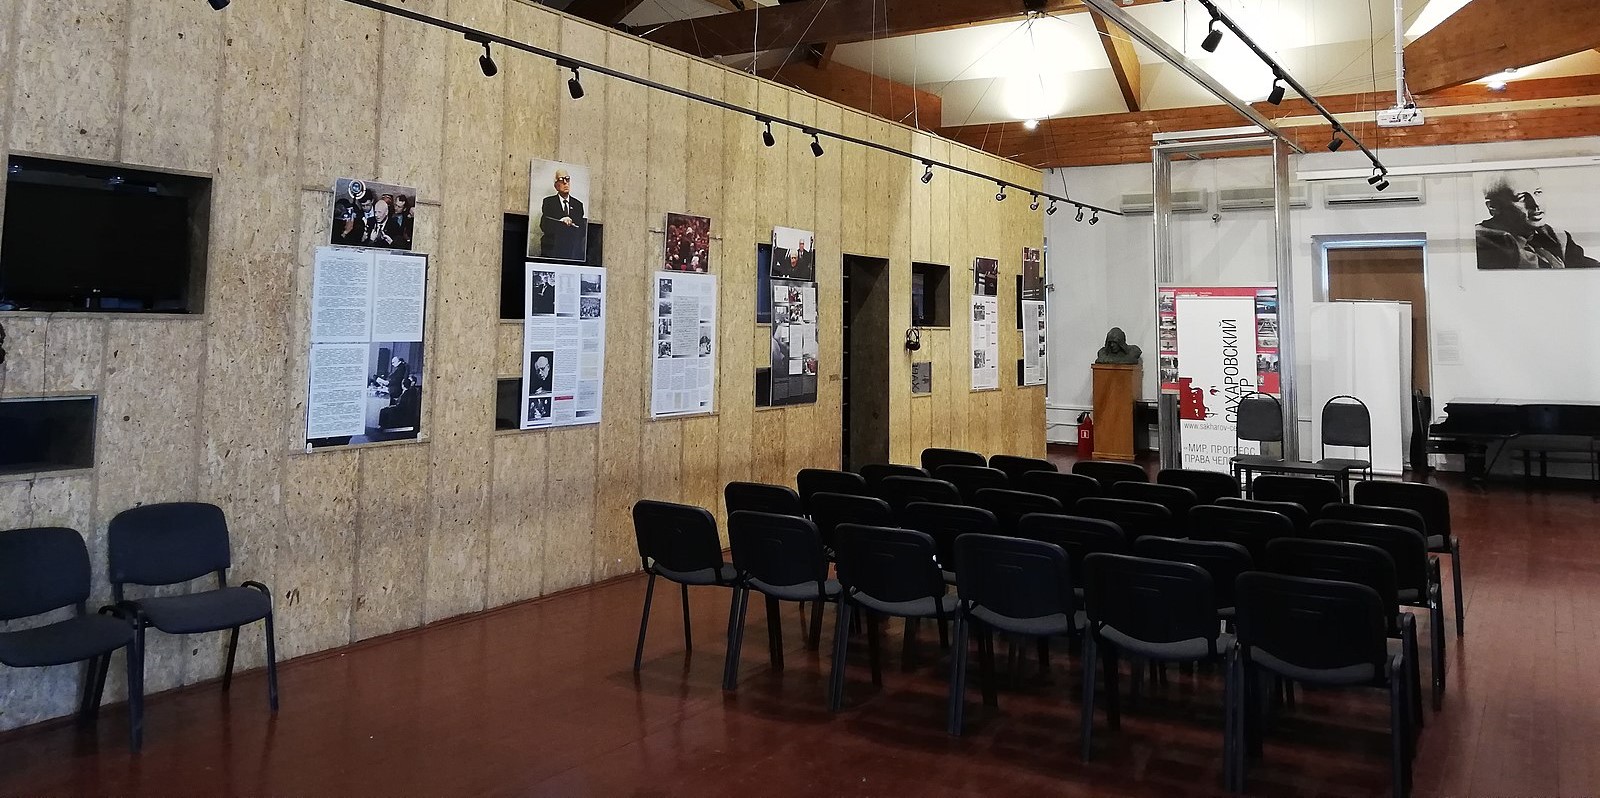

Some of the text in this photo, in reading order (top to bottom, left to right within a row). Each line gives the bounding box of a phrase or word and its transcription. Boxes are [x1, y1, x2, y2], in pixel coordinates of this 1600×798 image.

[1219, 319, 1240, 423] САХАРОВСКИЙ
[1184, 453, 1231, 465] ПРАВА ЧЕЛ
